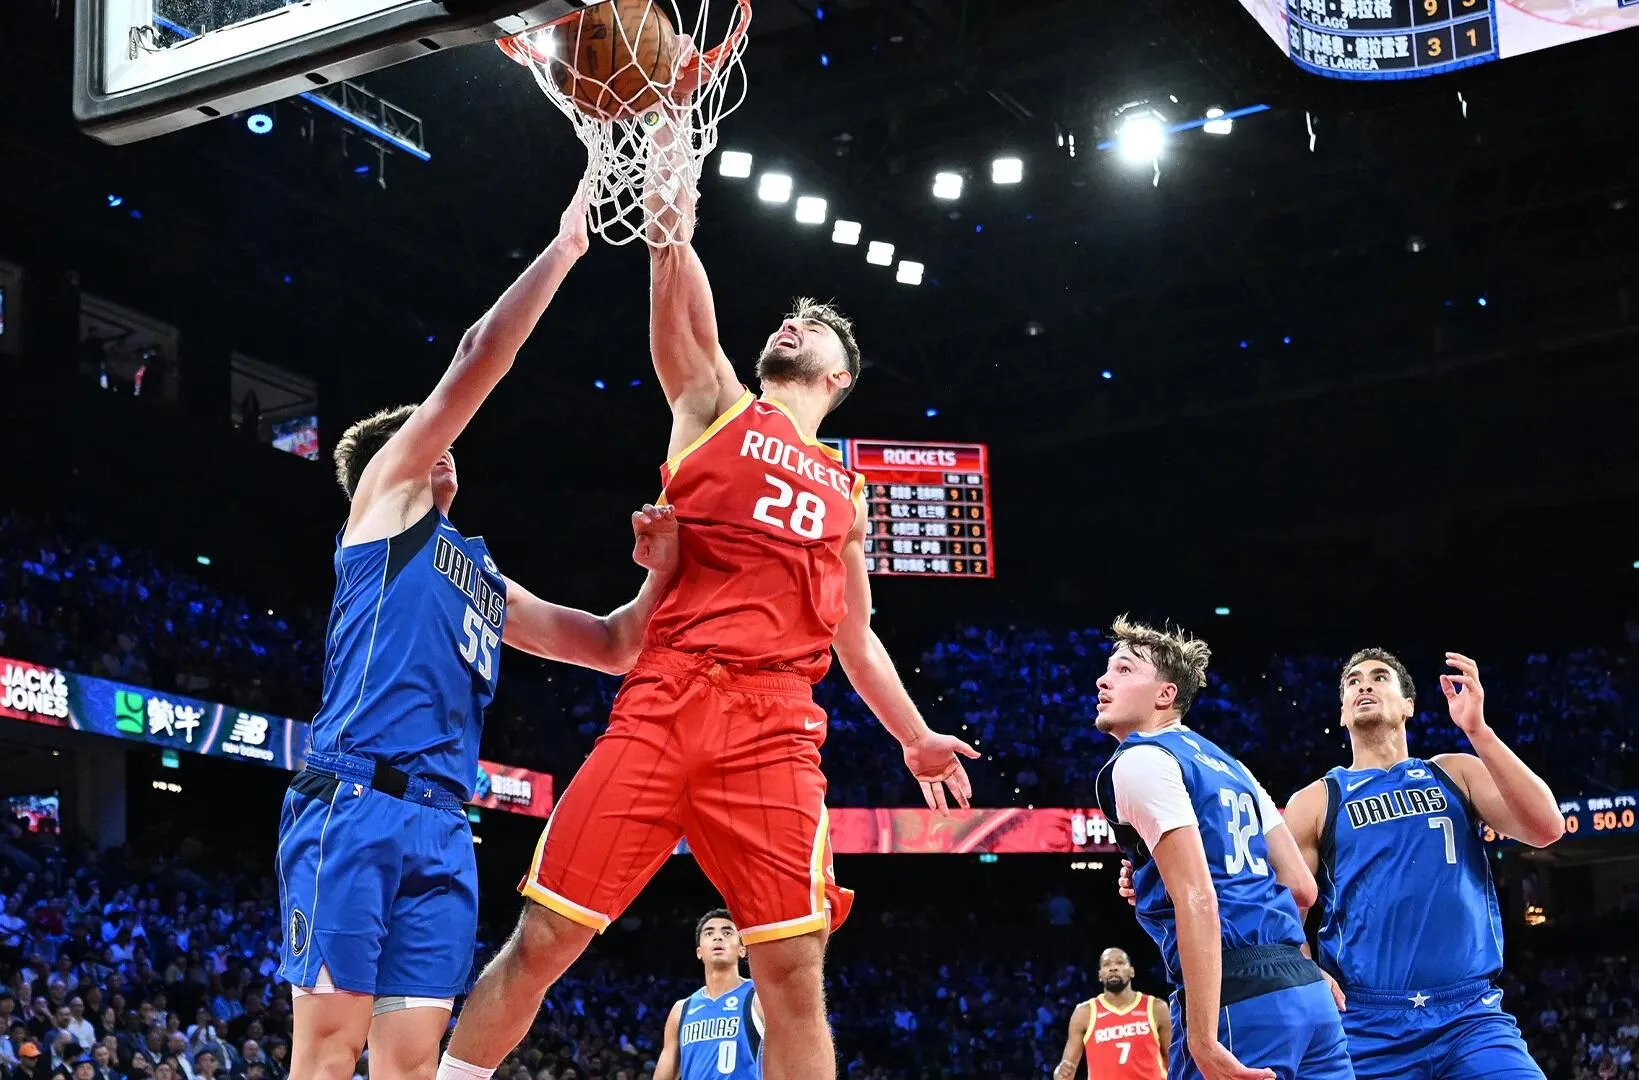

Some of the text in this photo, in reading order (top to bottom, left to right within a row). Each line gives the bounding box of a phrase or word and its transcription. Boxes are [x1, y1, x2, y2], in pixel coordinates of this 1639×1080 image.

[1311, 12, 1349, 29] FLAGG
[1424, 0, 1438, 17] 9
[1427, 37, 1442, 57] 3
[1466, 28, 1477, 47] 1
[1314, 53, 1328, 66] DE
[1330, 56, 1379, 71] LARREA
[739, 429, 850, 501] ROCKETS
[883, 448, 957, 467] ROCKETS
[752, 473, 826, 540] 28
[950, 487, 959, 500] 9
[971, 488, 978, 501] 1
[970, 507, 980, 519] 0
[952, 524, 961, 536] 7
[971, 525, 981, 537] 0
[953, 543, 962, 555] 2
[972, 543, 982, 555] 0
[954, 561, 963, 573] 5
[974, 561, 983, 573] 2
[433, 534, 504, 629] DALLAS
[459, 604, 500, 681] 55
[0, 663, 69, 698] JACK&
[0, 686, 69, 719] JONES
[147, 696, 201, 744] 蒙牛
[240, 743, 275, 761] balance
[1345, 786, 1448, 830] DALLAS
[1593, 808, 1635, 831] 50.0
[1220, 787, 1269, 877] 32
[1427, 816, 1458, 865] 7
[682, 1016, 741, 1047] DALLAS
[1094, 1021, 1151, 1044] ROCKETS
[717, 1040, 738, 1075] 0
[1115, 1042, 1132, 1065] 7
